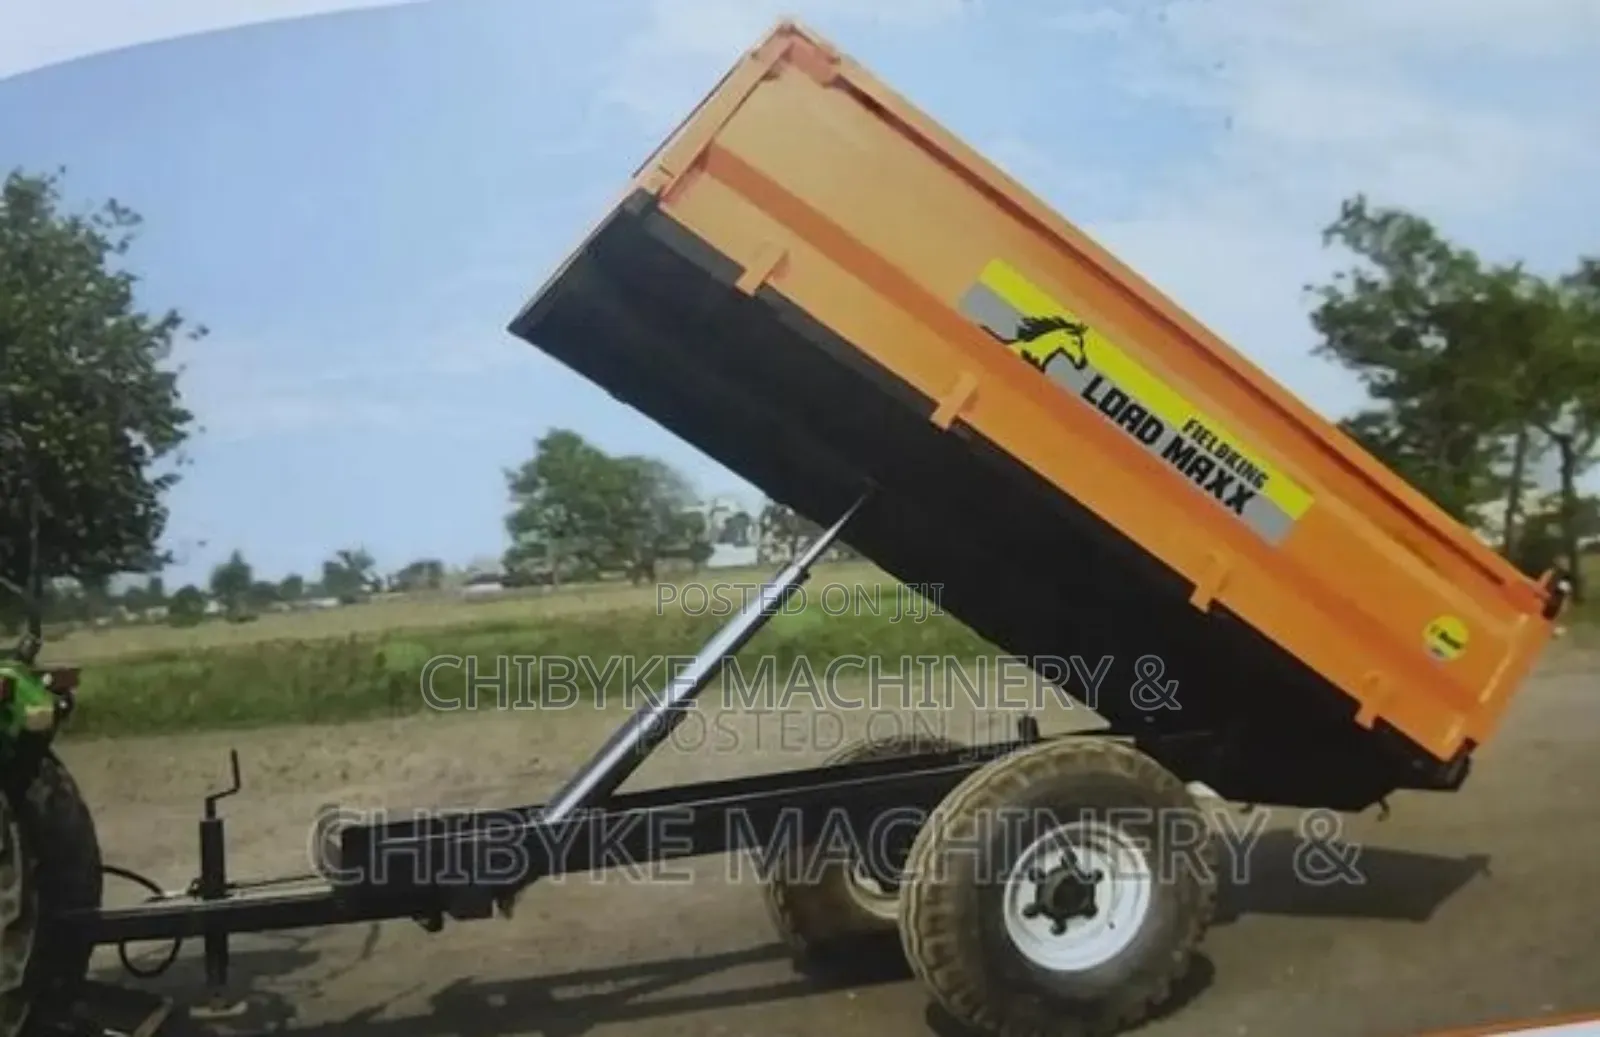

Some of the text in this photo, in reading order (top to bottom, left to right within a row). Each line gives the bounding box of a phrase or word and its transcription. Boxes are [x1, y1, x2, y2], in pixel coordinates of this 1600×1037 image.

[1081, 375, 1256, 516] LOAD MAXX
[1180, 417, 1269, 490] FIELDKING
